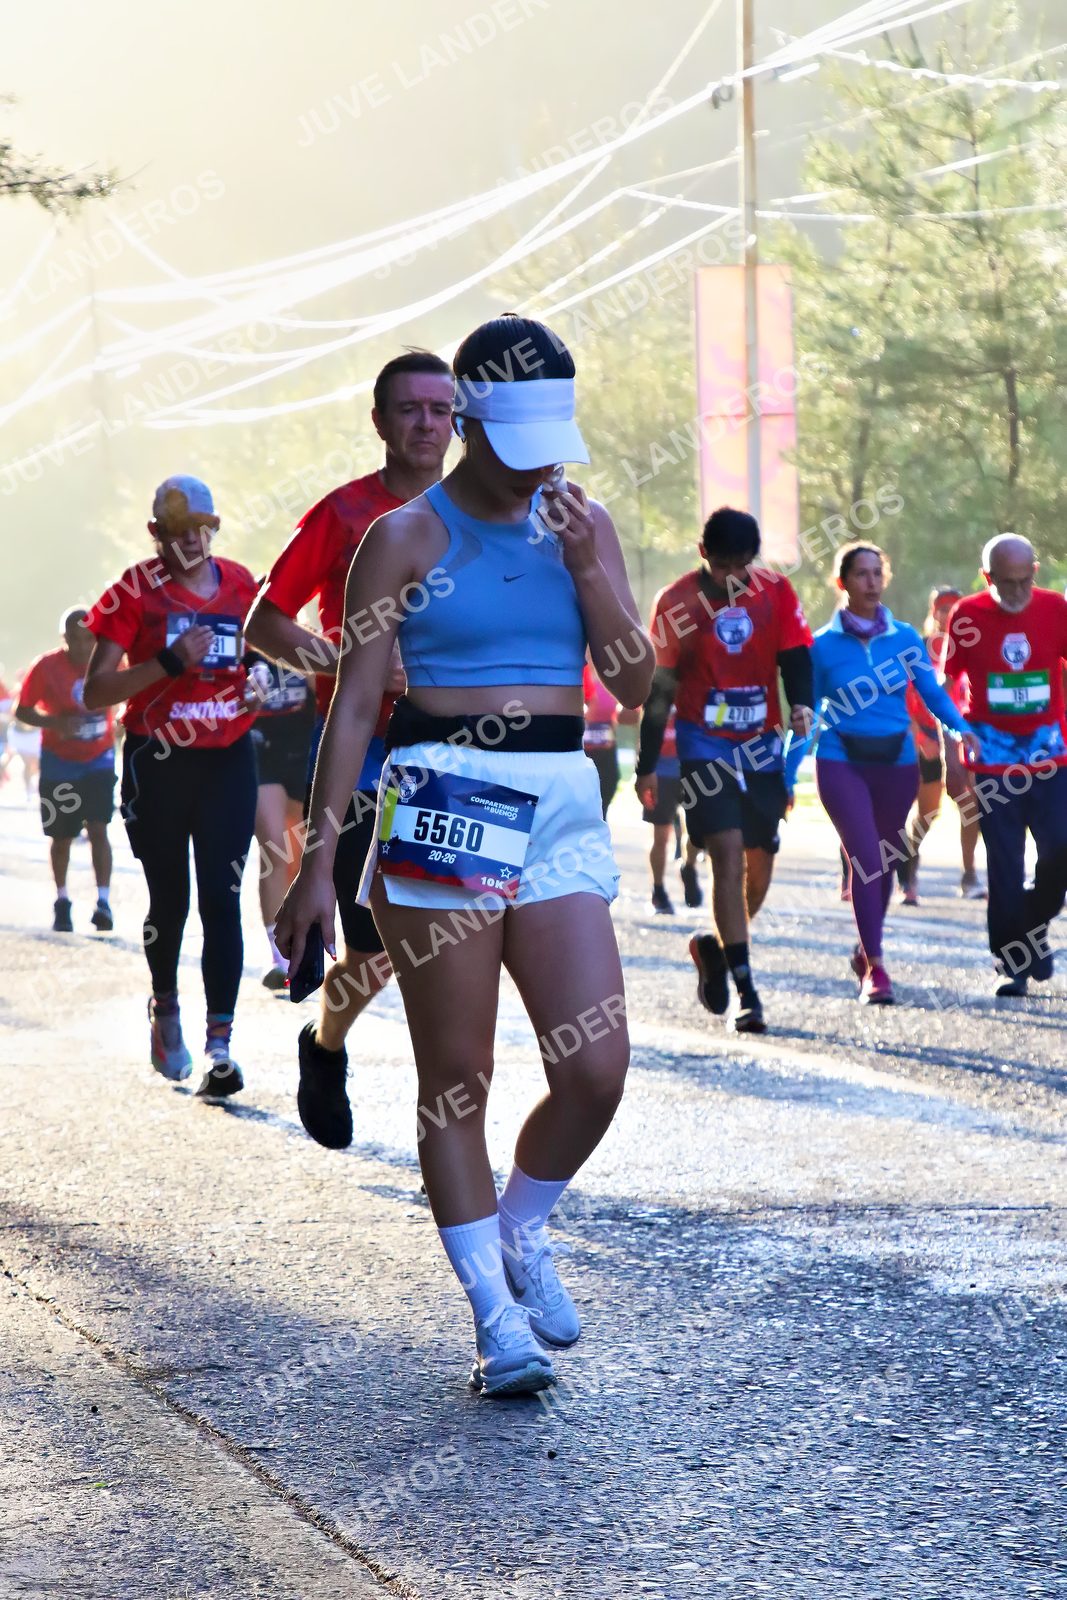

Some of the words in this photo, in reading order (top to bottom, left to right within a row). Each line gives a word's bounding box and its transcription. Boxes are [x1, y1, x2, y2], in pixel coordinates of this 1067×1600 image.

[470, 796, 519, 812] COMPARTIMOS
[413, 809, 485, 853] 5560
[480, 876, 504, 890] 10K
